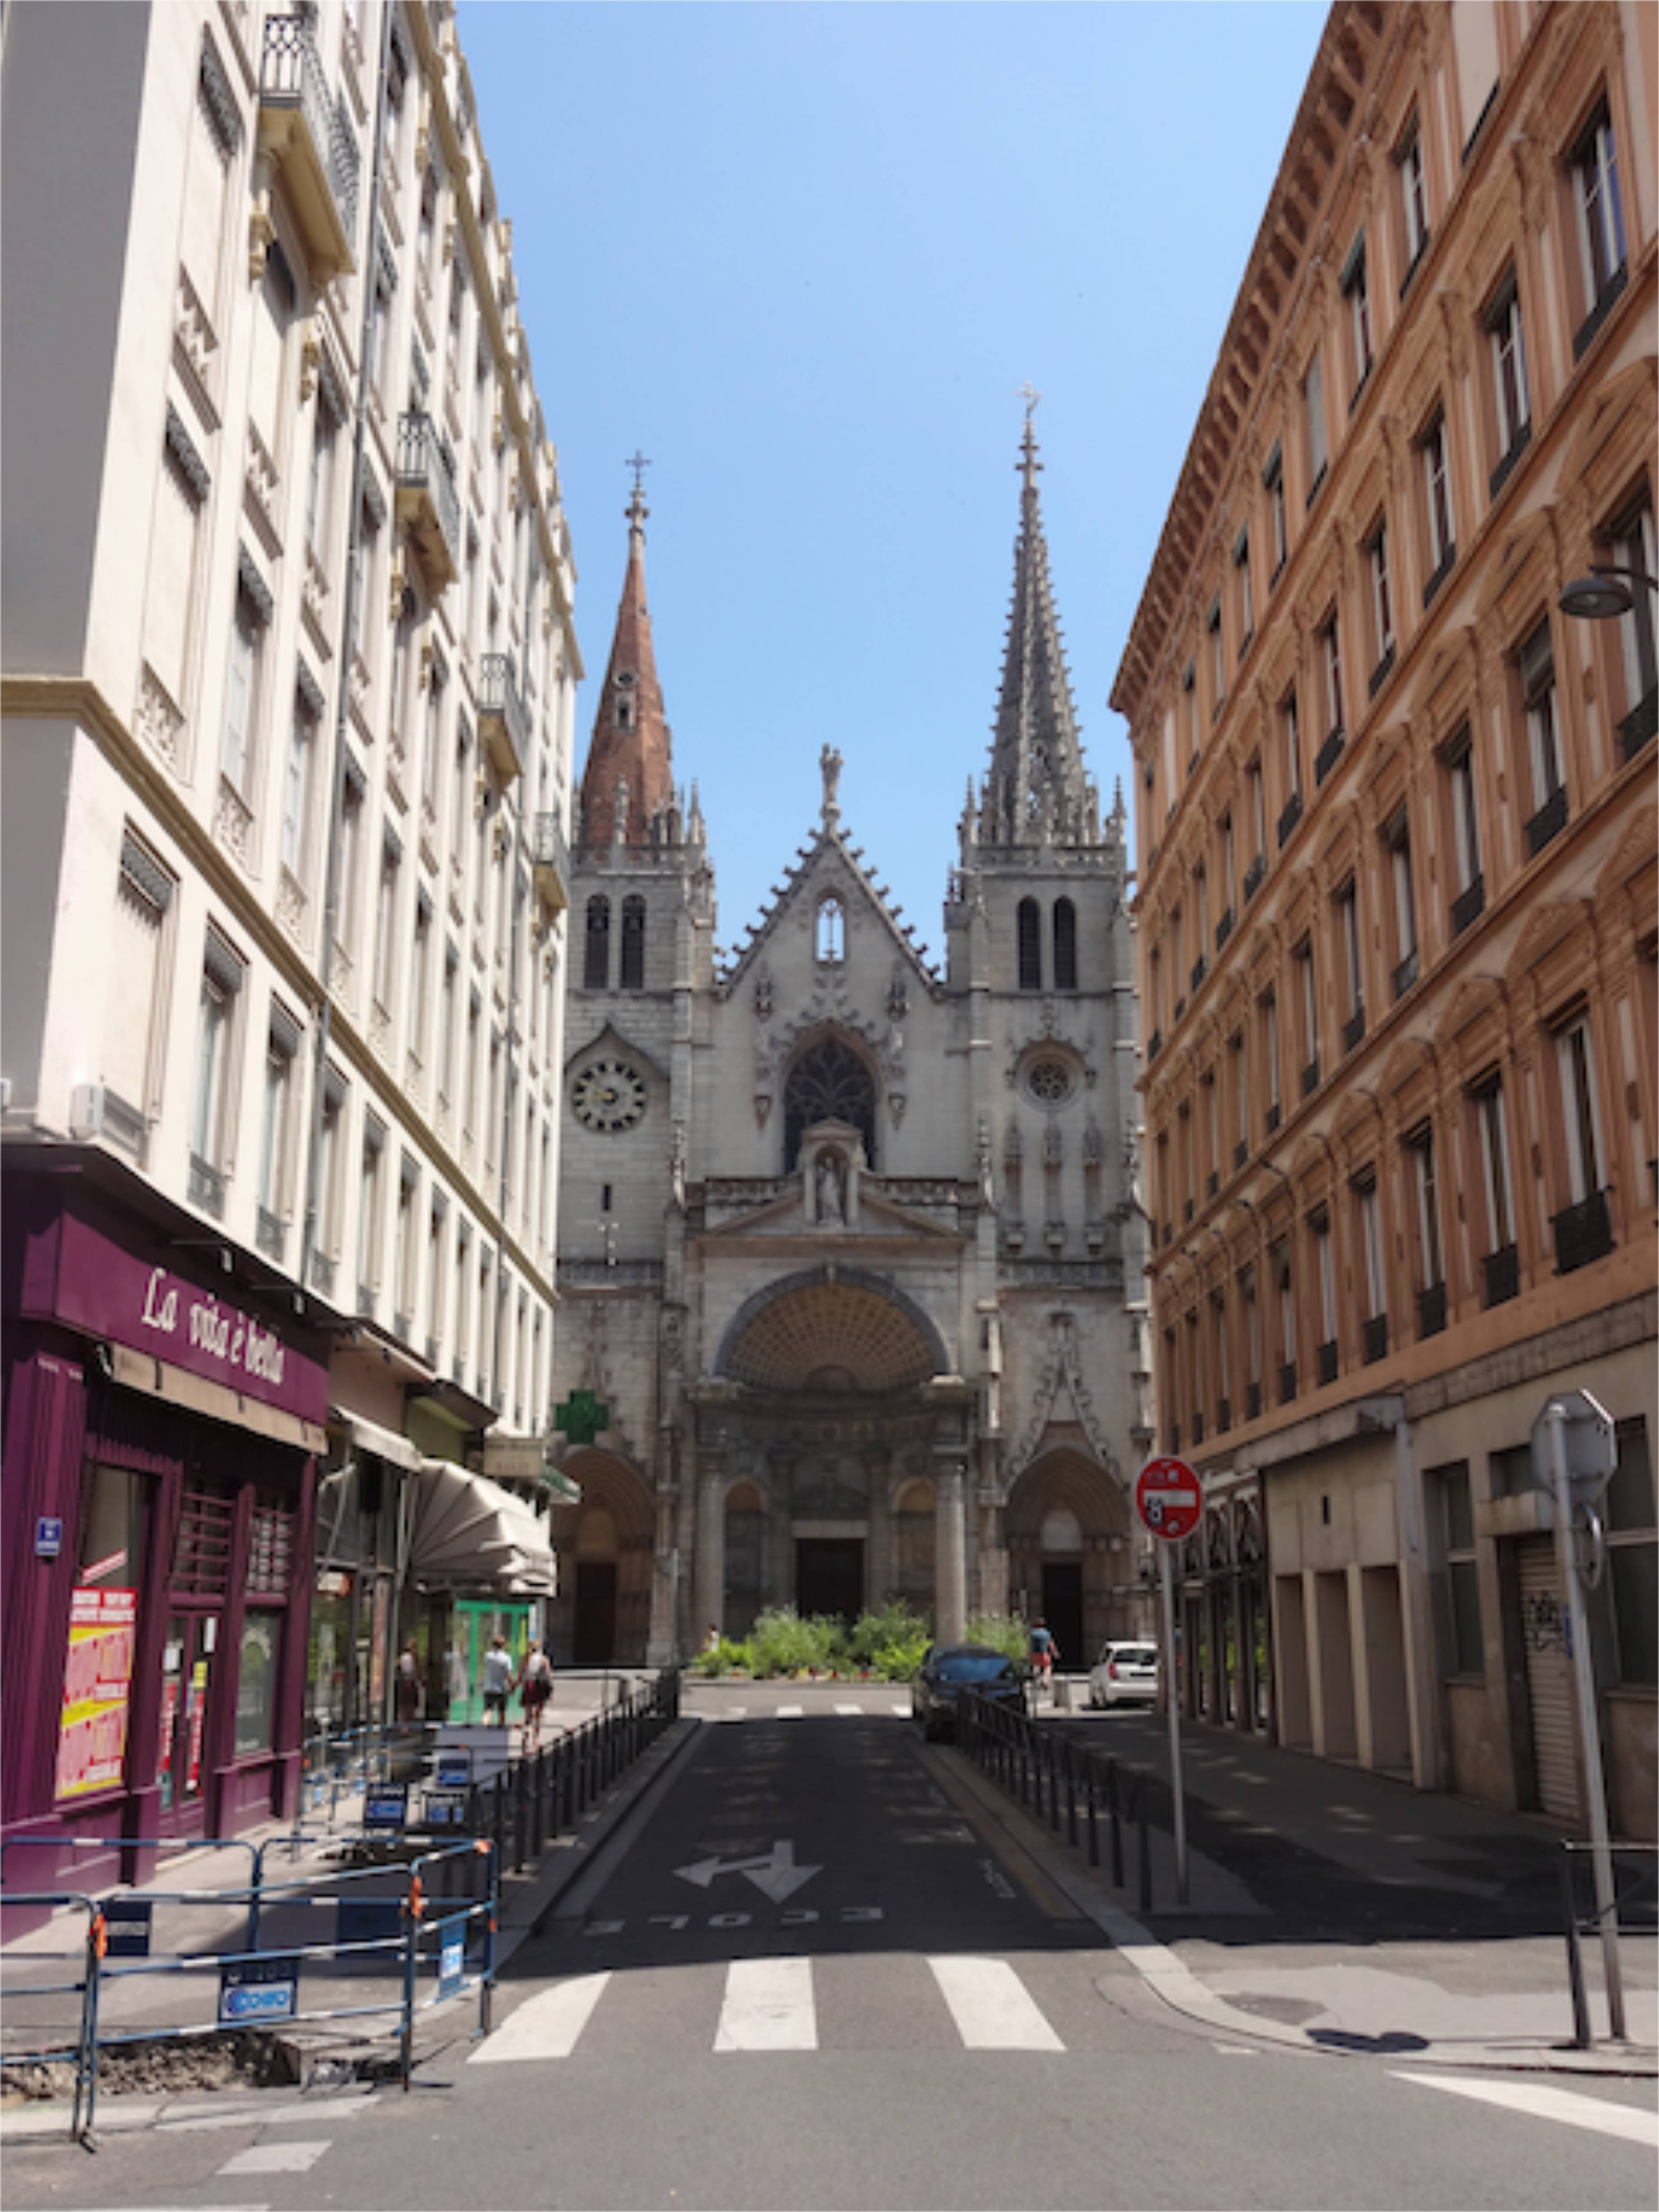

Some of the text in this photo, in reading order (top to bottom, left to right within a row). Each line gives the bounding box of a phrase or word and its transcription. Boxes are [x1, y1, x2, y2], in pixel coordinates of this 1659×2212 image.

[141, 1267, 178, 1332] La
[190, 1292, 230, 1359] vita
[245, 1318, 284, 1385] bella
